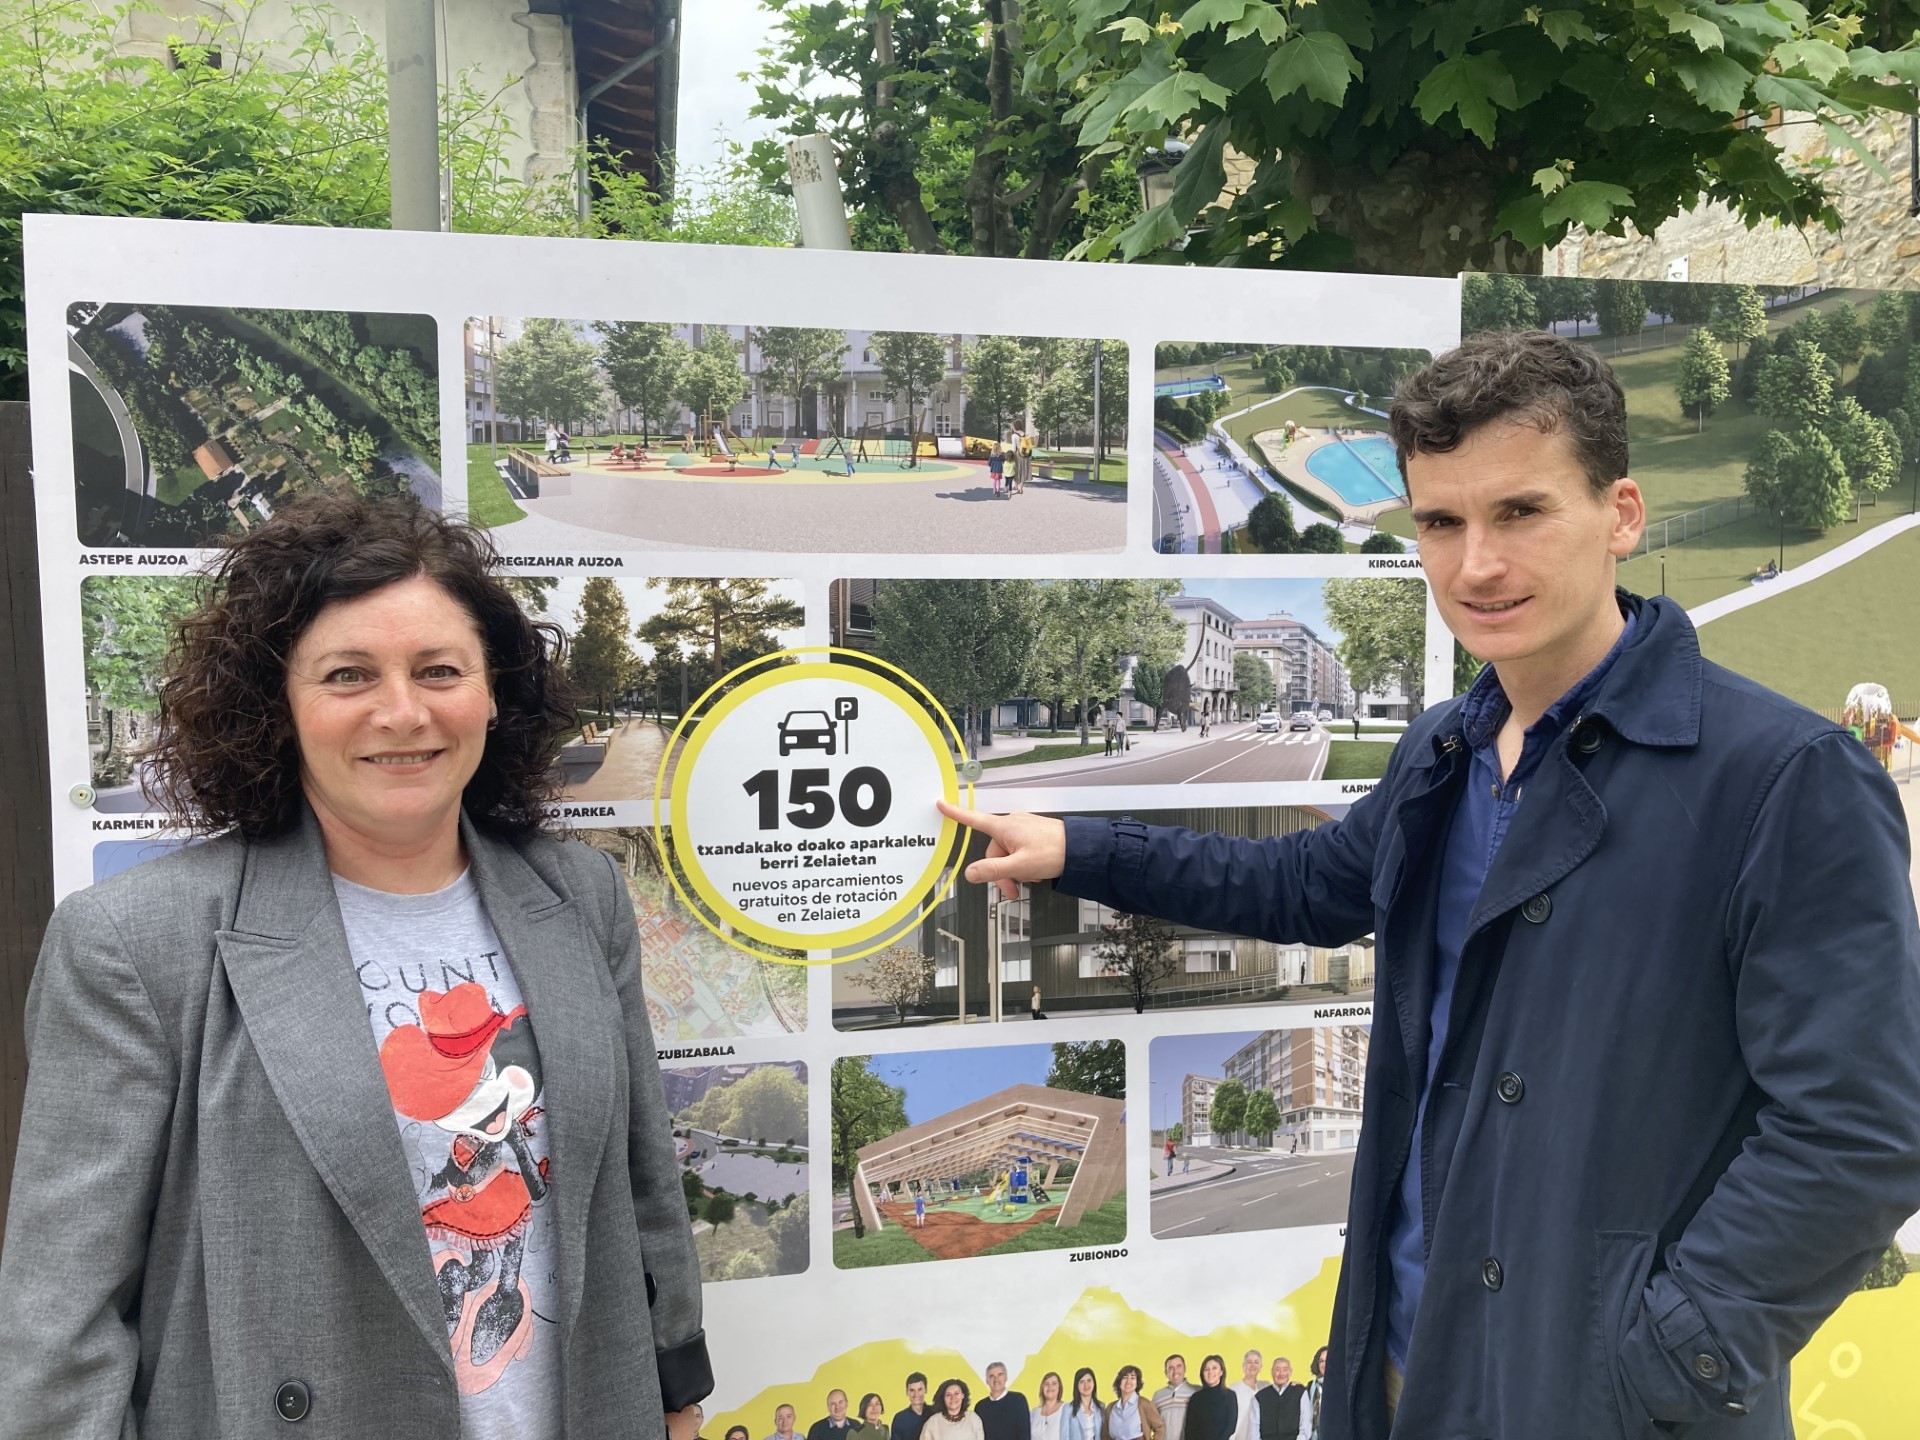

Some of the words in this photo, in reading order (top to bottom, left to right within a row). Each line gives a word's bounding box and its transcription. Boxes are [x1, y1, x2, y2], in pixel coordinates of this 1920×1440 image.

[79, 554, 133, 565] ASTEPE
[138, 554, 188, 565] AUZOA
[578, 557, 624, 567] AUZOA
[840, 701, 852, 716] P
[742, 766, 892, 830] 150
[564, 806, 615, 818] PARKEA
[92, 819, 154, 830] KARMEN
[697, 841, 793, 856] txandakako
[797, 838, 846, 852] doako
[849, 834, 936, 852] aparkaleku
[760, 855, 799, 870] berri
[803, 853, 877, 868] Zelaietan
[732, 880, 788, 892] nuevos
[792, 873, 904, 890] aparcamientos
[738, 892, 808, 911] gratuitos
[811, 891, 832, 906] de
[836, 887, 898, 904] rotación
[777, 911, 796, 922] en
[801, 907, 861, 922] Zelaieta
[1314, 1006, 1371, 1018] NAFARROA
[657, 1045, 735, 1060] ZUBIZABALA
[1069, 1248, 1128, 1262] ZUBIONDO
